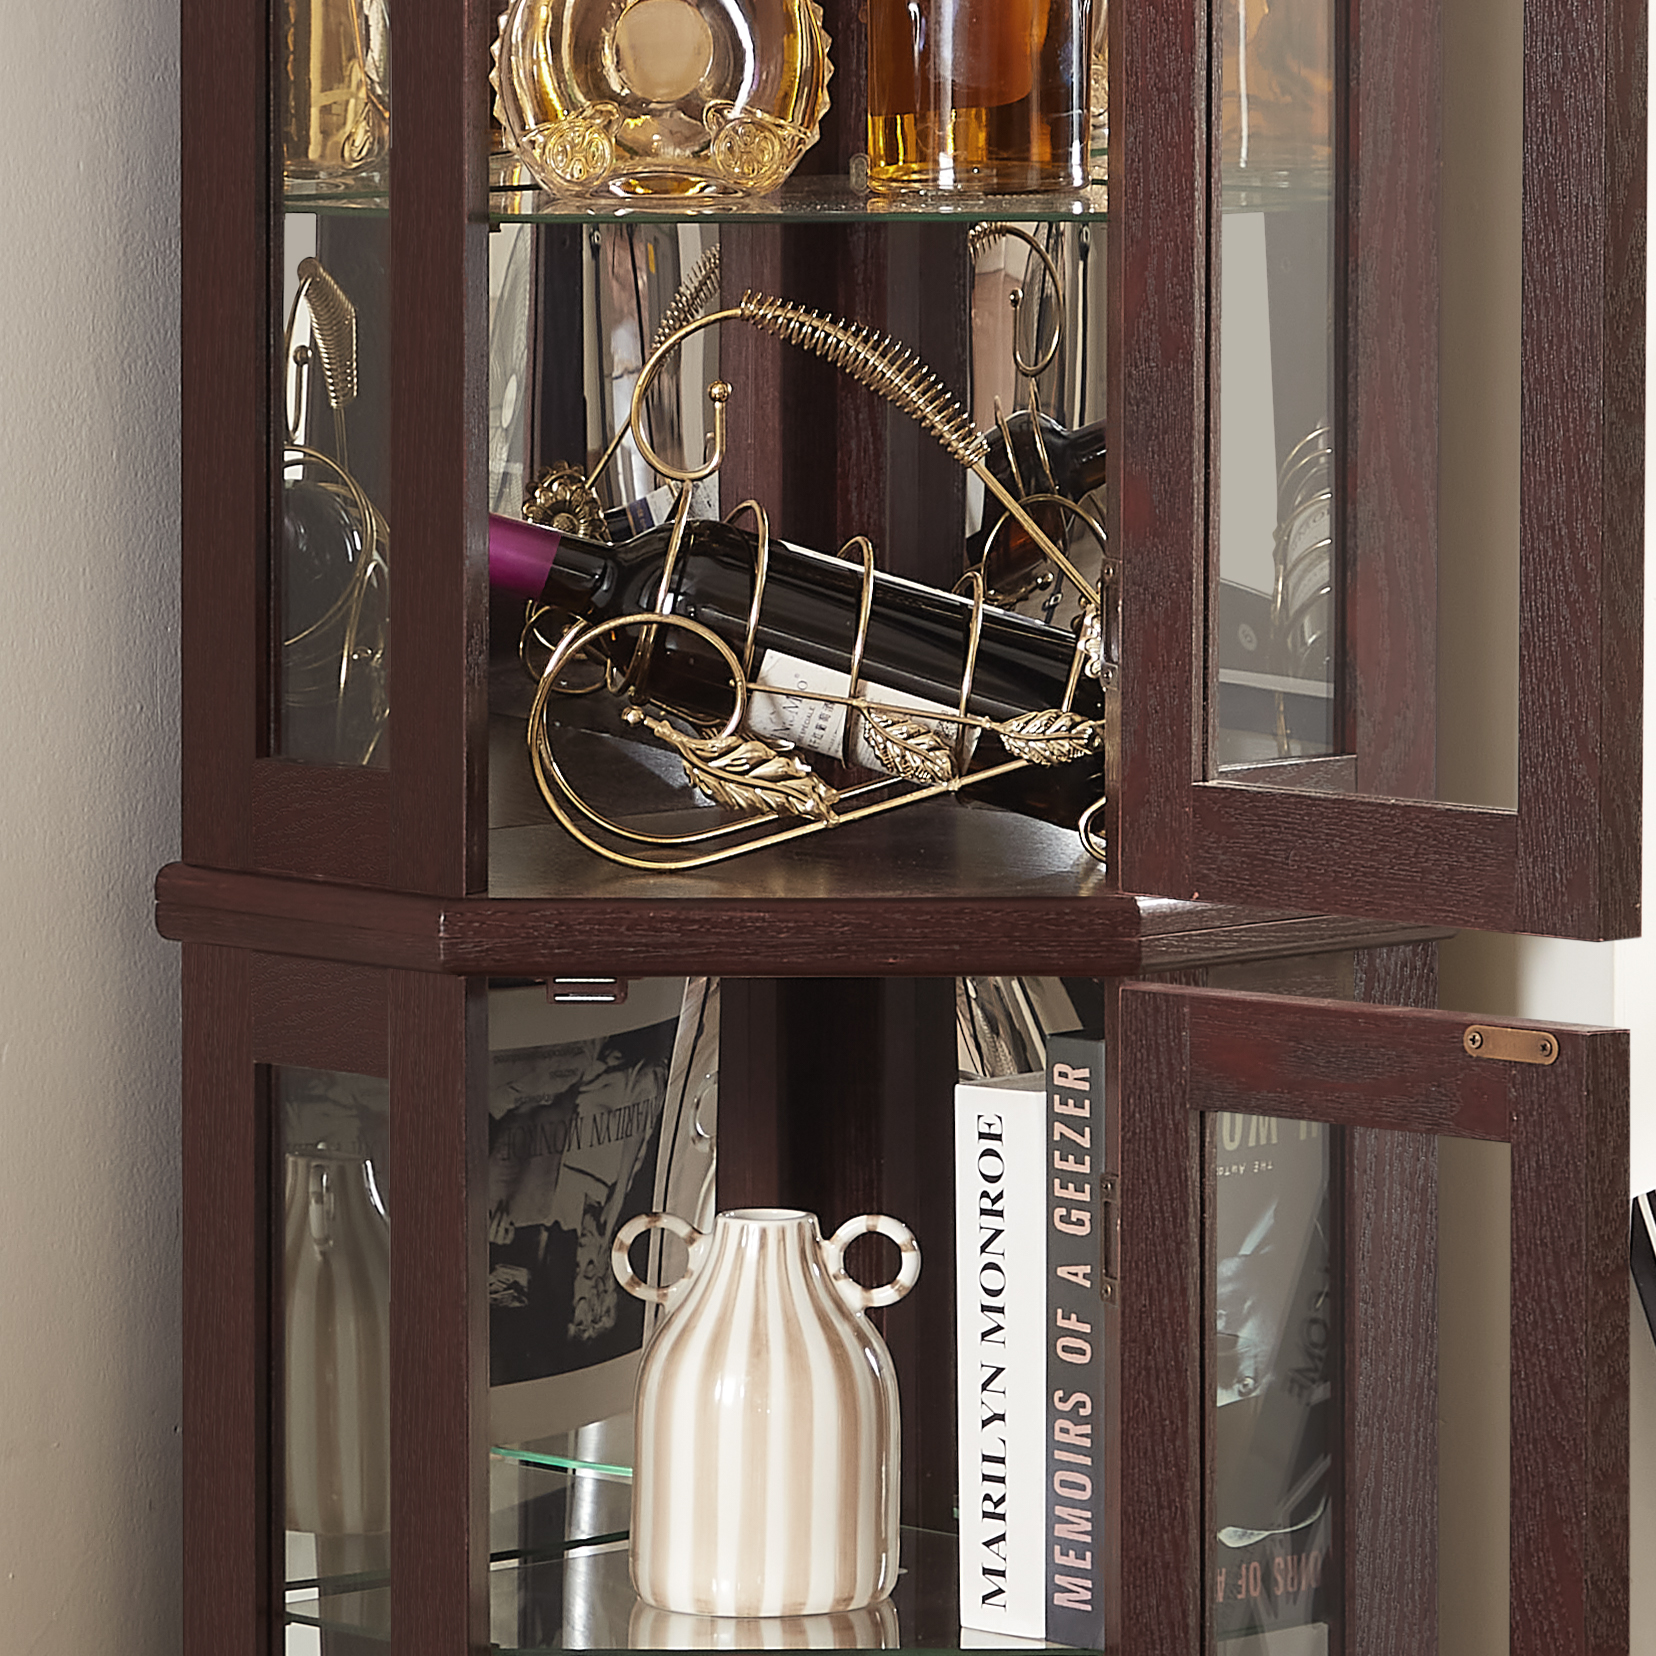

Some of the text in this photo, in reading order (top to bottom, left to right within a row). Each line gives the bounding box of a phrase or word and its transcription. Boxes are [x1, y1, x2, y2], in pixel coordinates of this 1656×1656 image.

[589, 1095, 659, 1148] MARILYN
[977, 1112, 1007, 1613] MARILYN MONROE
[1052, 1061, 1092, 1613] MEMOIRS OF A GEEZER
